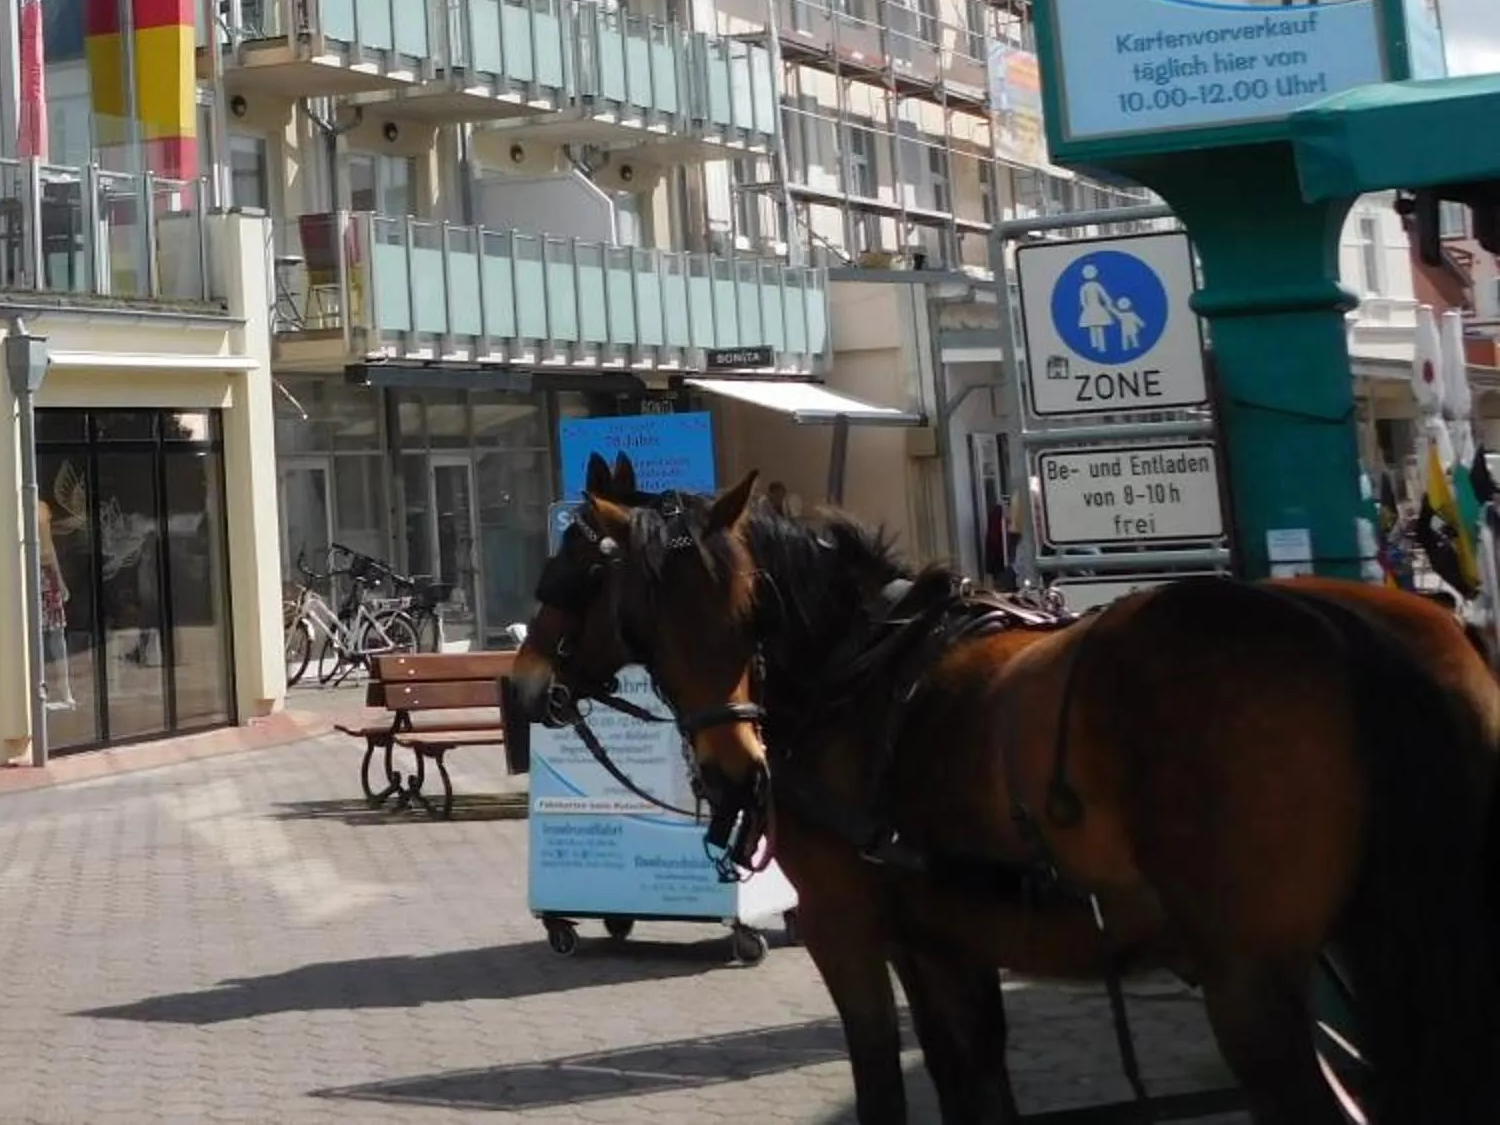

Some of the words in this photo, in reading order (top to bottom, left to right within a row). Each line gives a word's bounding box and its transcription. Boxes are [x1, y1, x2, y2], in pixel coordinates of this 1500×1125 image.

[1115, 12, 1319, 54] Kartenvorverkauf
[1133, 55, 1208, 87] täglich
[1213, 52, 1257, 77] hier
[1263, 48, 1307, 69] von
[1117, 77, 1269, 113] 10.00-12.00
[1276, 72, 1327, 98] Uhr!
[1074, 370, 1164, 402] ZONE
[1046, 460, 1080, 480] Be-
[1088, 458, 1122, 478] und
[1131, 452, 1210, 476] Entladen
[1083, 489, 1116, 508] von
[1113, 514, 1157, 536] frei
